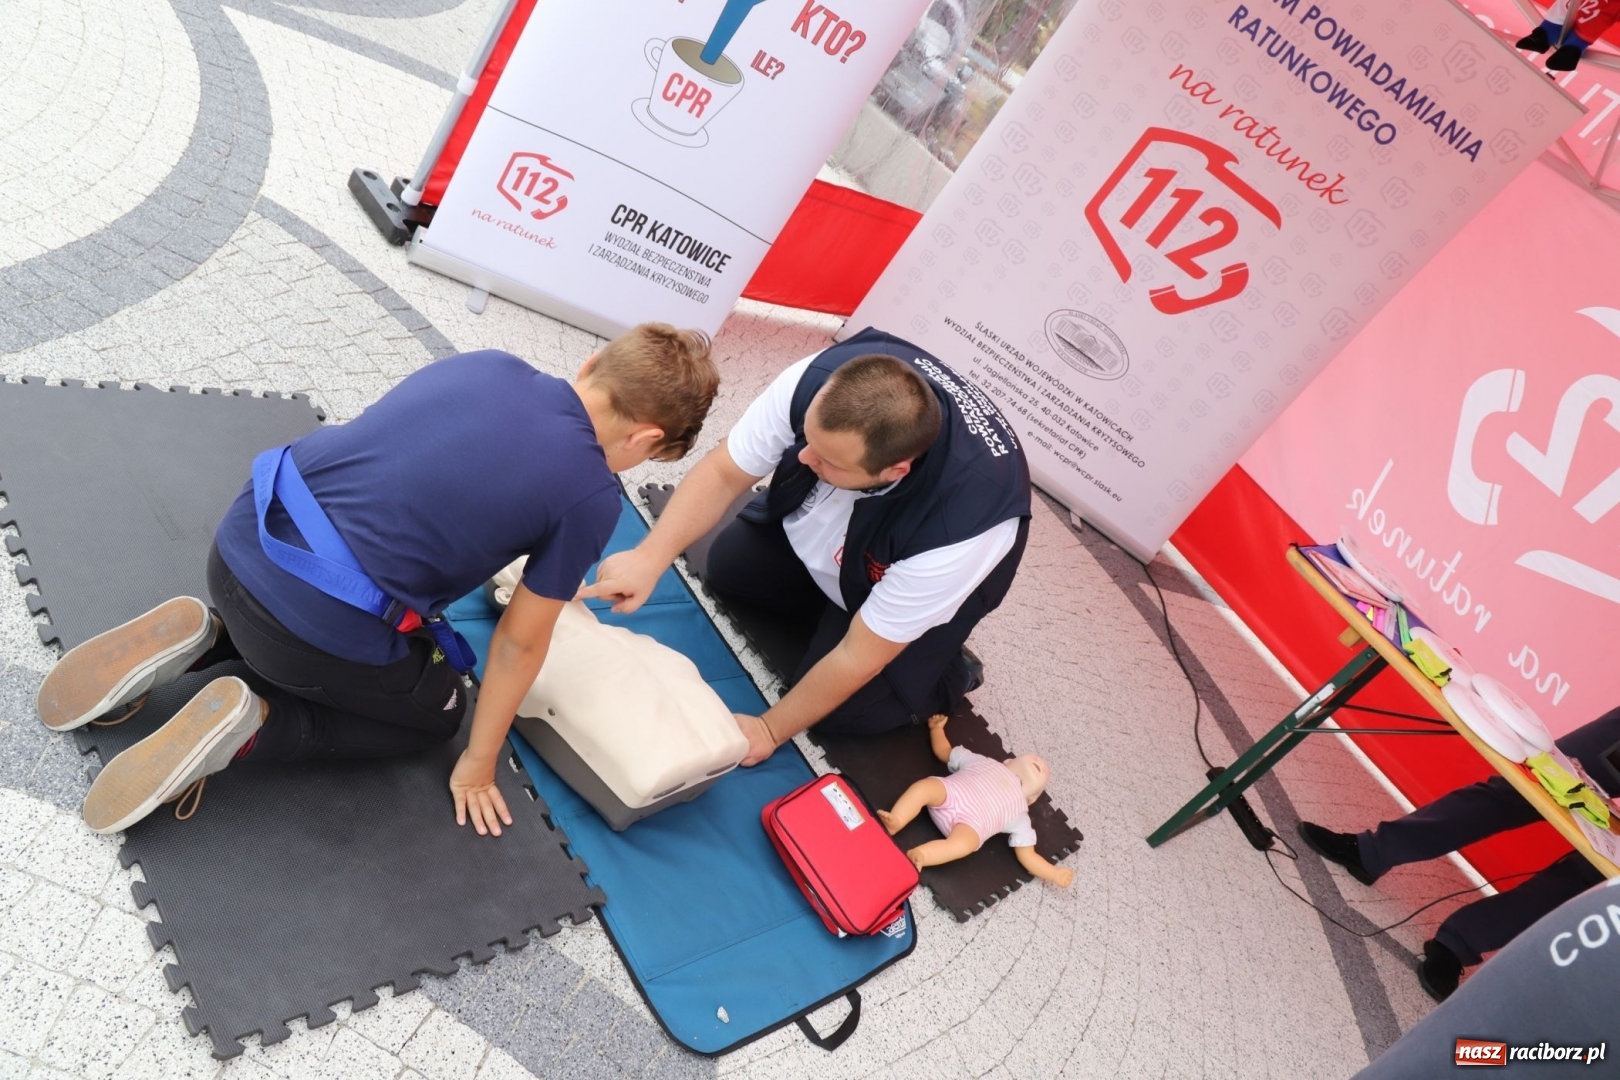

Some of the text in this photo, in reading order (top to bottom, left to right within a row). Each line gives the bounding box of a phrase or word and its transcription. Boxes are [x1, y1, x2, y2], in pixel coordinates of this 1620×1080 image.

[750, 49, 786, 81] ILE?
[790, 0, 866, 65] KTO?
[661, 71, 712, 119] CPR
[1227, 4, 1397, 145] RATUNKOWEGO
[1299, 5, 1484, 163] POWIADAMIANIA
[1168, 63, 1349, 205] na ratunek
[511, 165, 560, 206] 112
[471, 207, 557, 251] na ratunek
[610, 203, 732, 275] CPR KATOWICE
[1119, 167, 1239, 280] 112
[592, 245, 653, 282] ZARZĄDZANIA
[650, 270, 710, 305] KRYZYSOWEGO
[603, 231, 712, 289] WYDZIAŁ BEZPIECZEŃSTWA
[943, 315, 976, 345] WYDZIAŁ
[976, 337, 1037, 389] BEZPIECZEŃSTWA
[1041, 387, 1092, 430] ZARZĄDZANIA
[1090, 424, 1145, 469] KRYZYSOWEGO
[968, 369, 1087, 460] tel. 32 207-74-68 (sekretariat CPR)
[972, 355, 983, 365] ul.
[982, 362, 1029, 401] Jagiellońska
[1041, 405, 1067, 427] 40-032
[1065, 421, 1099, 452] Katowice
[974, 319, 1134, 443] ŚLĄSKI URZĄD WOJEWÓDZKI W KATOWICACH
[1027, 430, 1123, 502] e-mail: wcpr@wcpr.slask.eu
